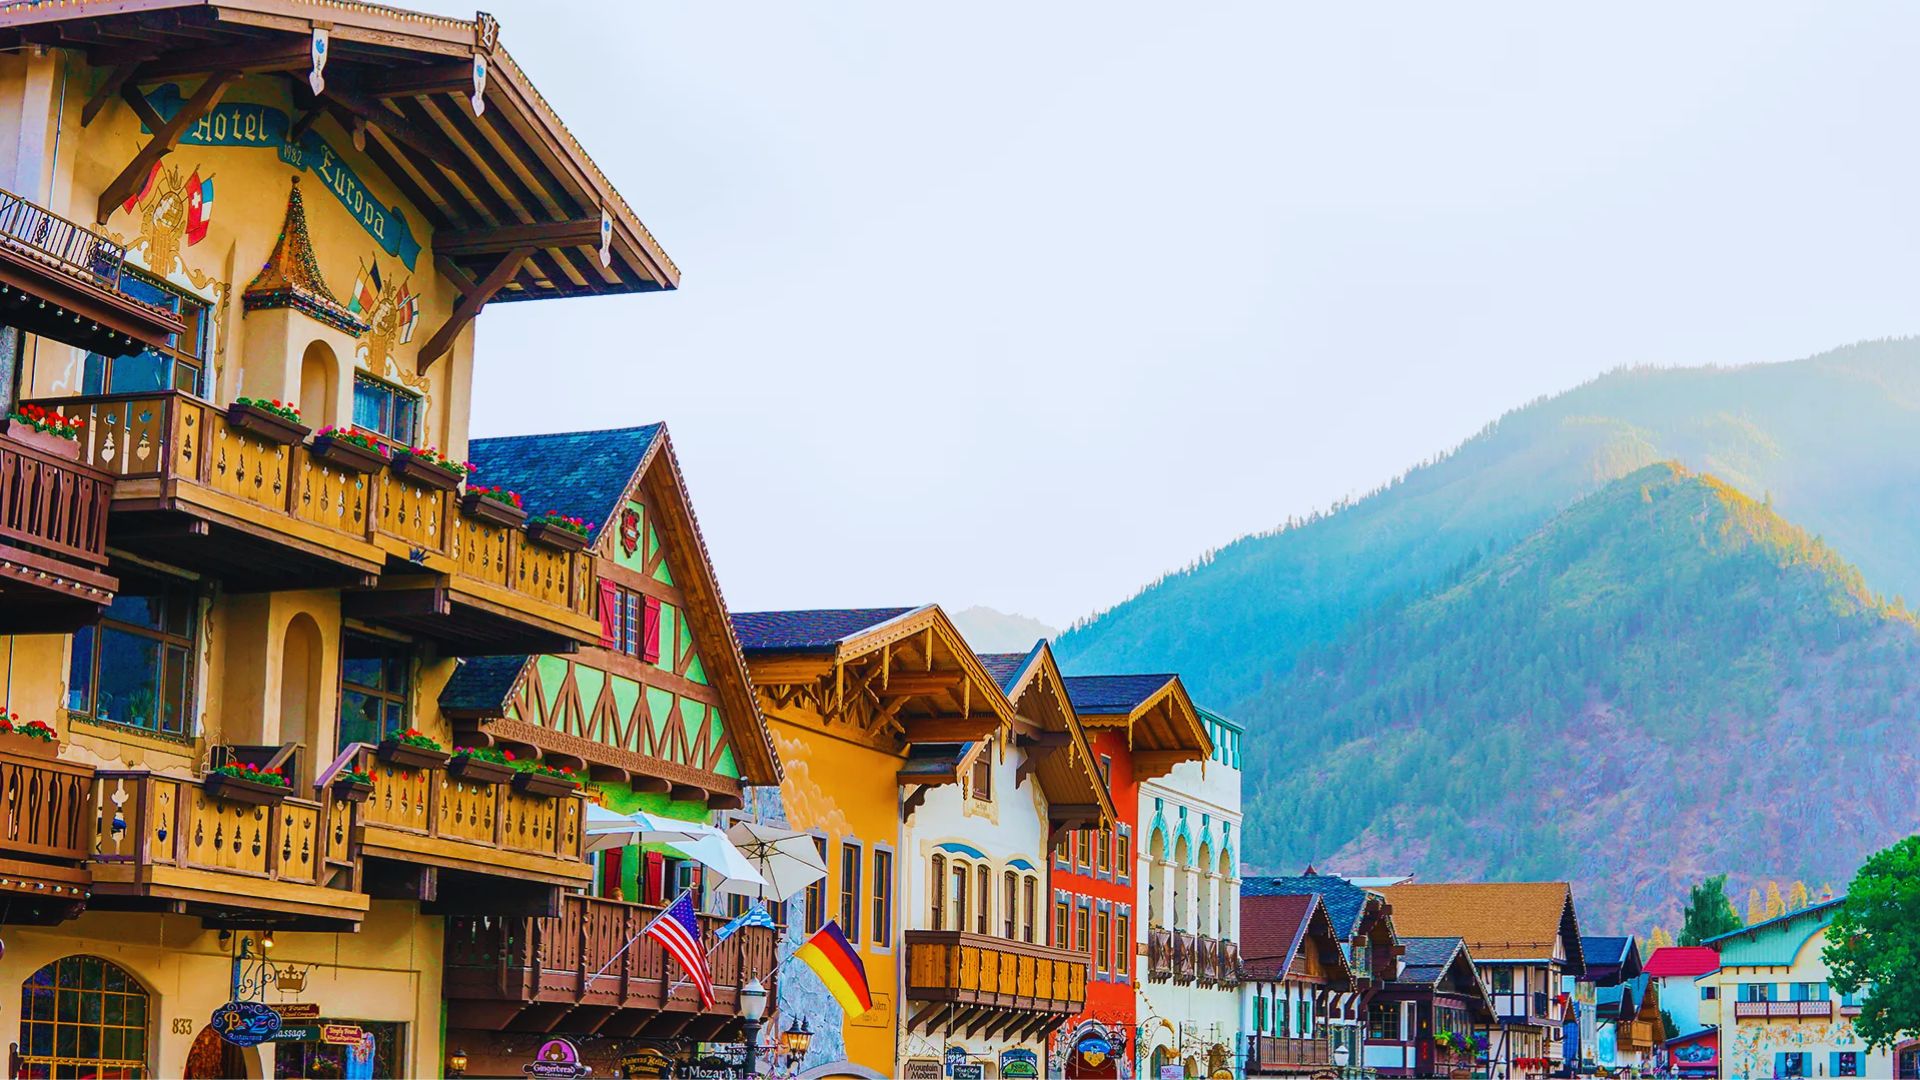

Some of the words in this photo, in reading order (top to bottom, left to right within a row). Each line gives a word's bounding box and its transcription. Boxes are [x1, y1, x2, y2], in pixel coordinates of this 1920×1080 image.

[192, 109, 269, 142] Hotel
[284, 144, 302, 166] 1982
[319, 144, 384, 239] Europa
[173, 1018, 192, 1035] 833
[533, 1064, 576, 1073] Gingerbread
[907, 1064, 938, 1072] Mountain
[911, 1071, 938, 1079] Modern
